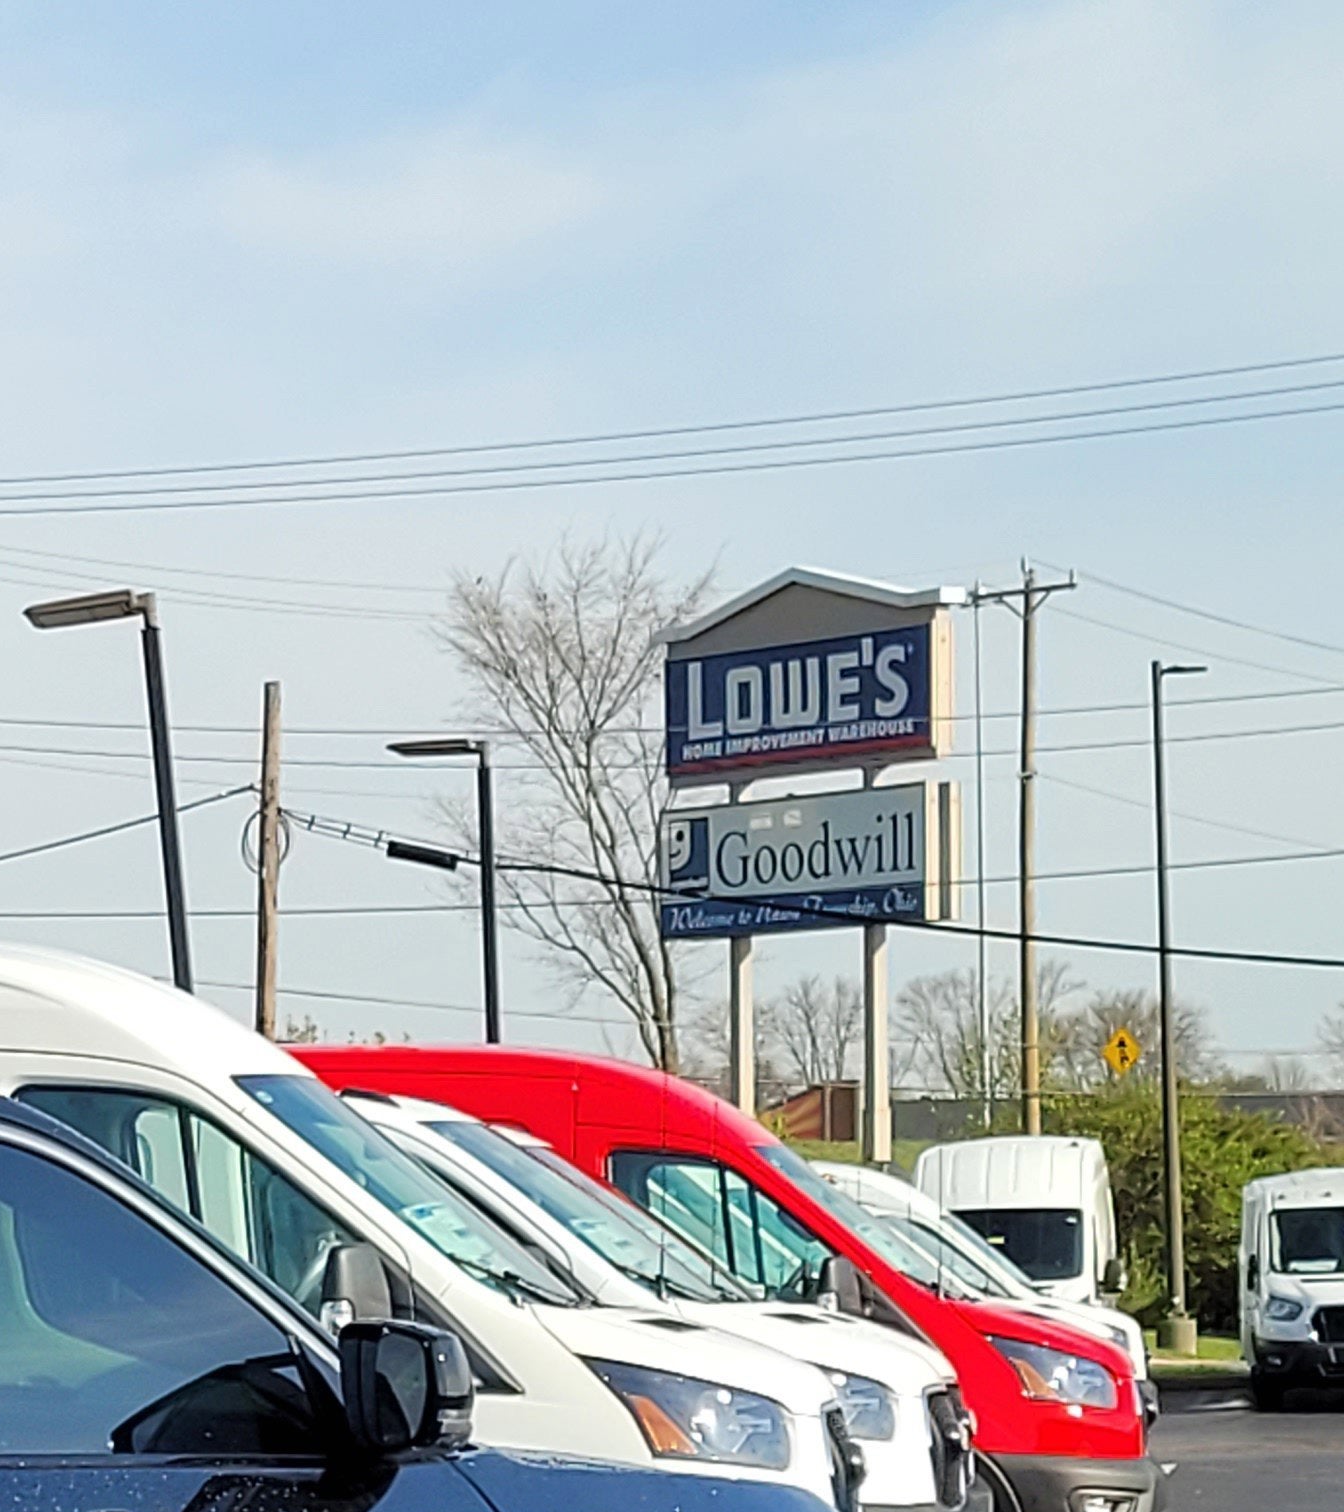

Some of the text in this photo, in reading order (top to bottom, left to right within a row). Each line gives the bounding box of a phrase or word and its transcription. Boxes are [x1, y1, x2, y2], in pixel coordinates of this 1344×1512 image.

[687, 637, 910, 741] LOWE'S
[682, 718, 915, 761] HOME IMPROVEMENT WAREHOUSE
[716, 811, 916, 888] Goodwill
